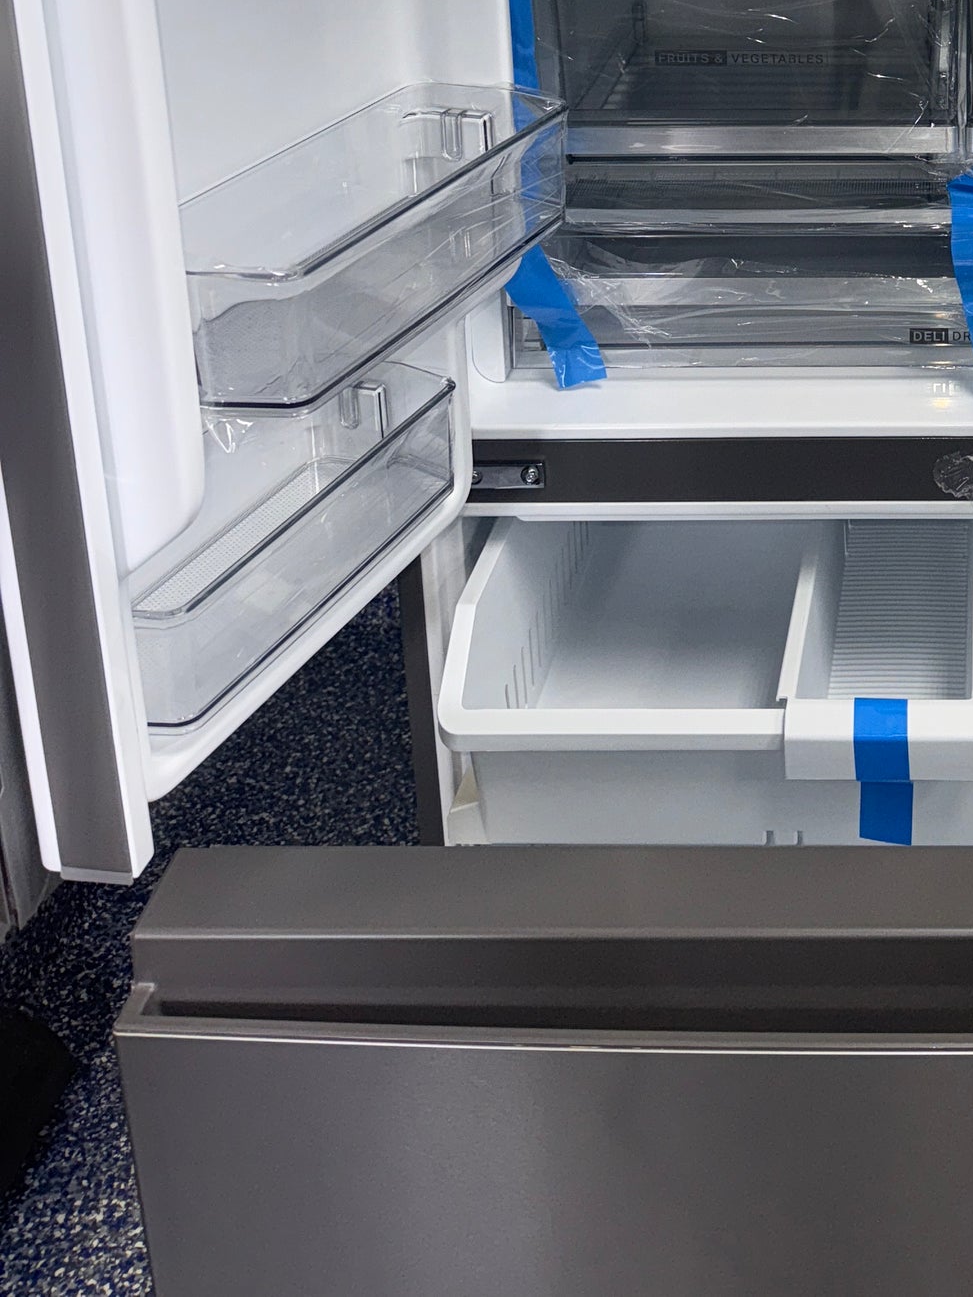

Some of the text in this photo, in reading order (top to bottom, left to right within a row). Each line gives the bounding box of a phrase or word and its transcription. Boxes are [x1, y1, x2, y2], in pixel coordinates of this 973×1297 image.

[658, 53, 710, 64] FRUITS
[732, 53, 824, 64] VEGETABLES
[913, 331, 946, 342] DELI
